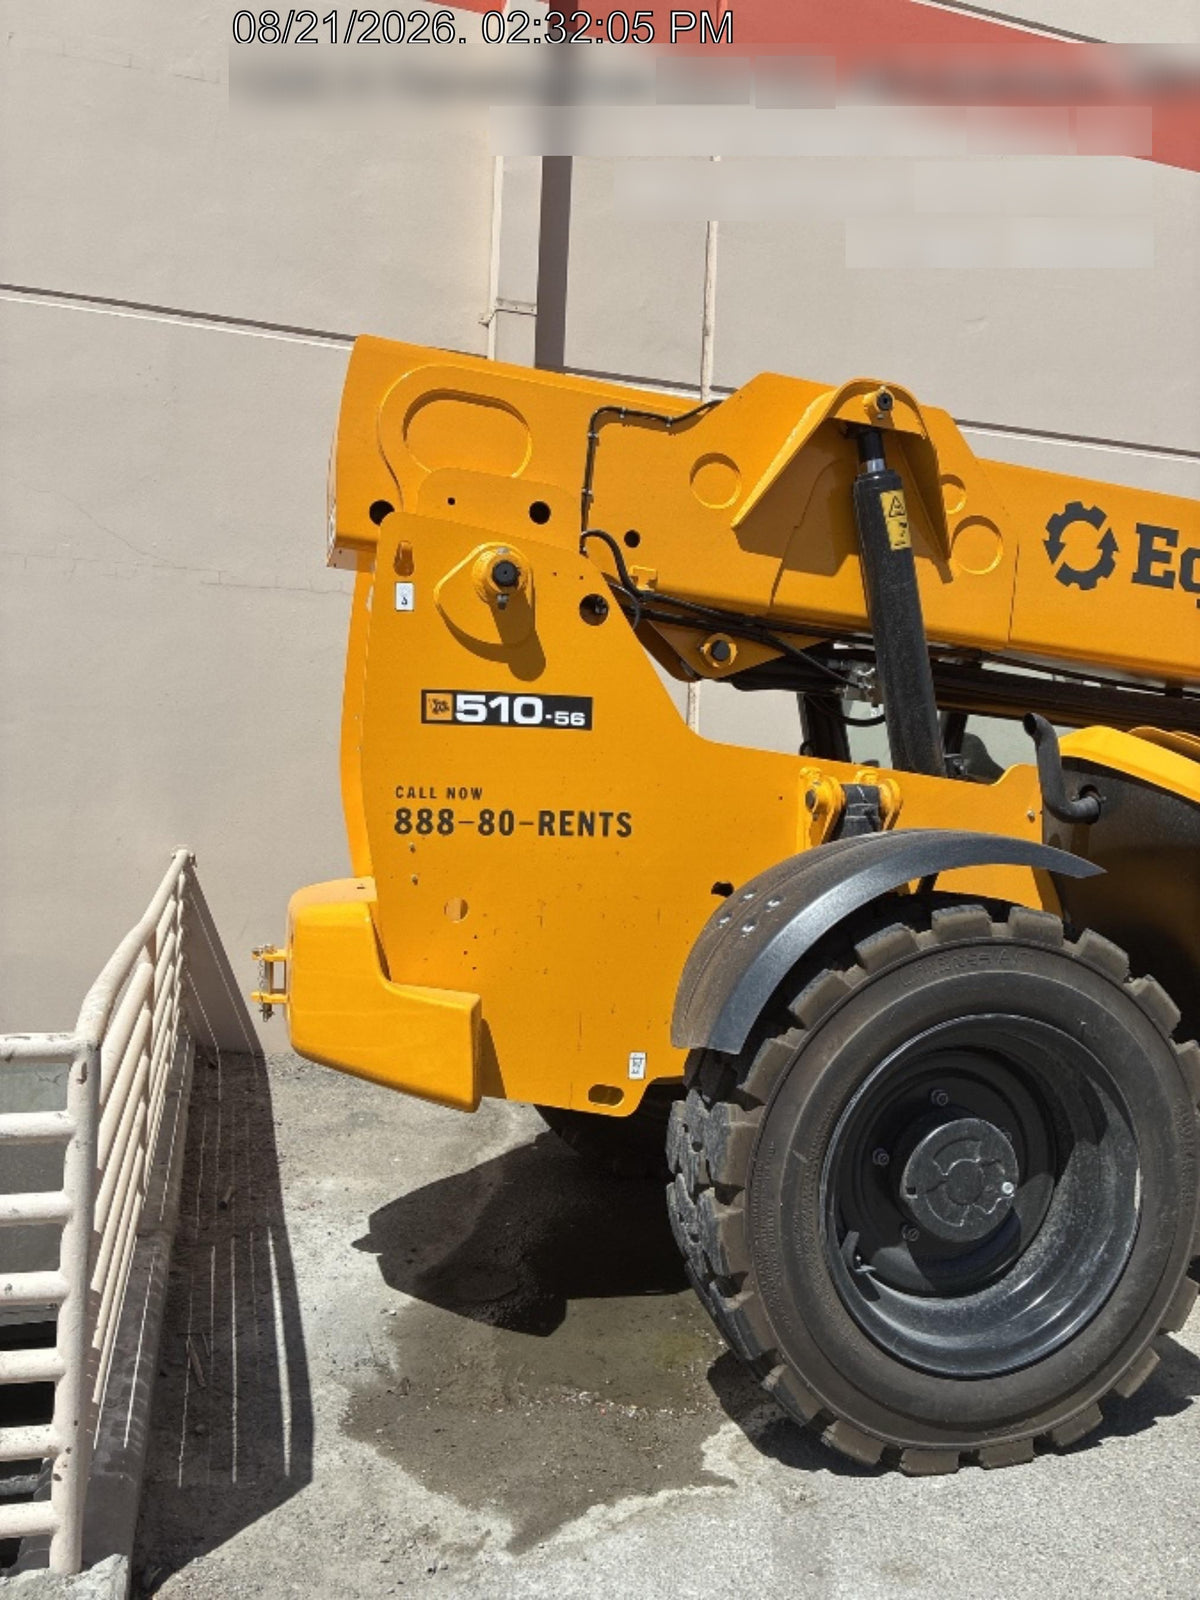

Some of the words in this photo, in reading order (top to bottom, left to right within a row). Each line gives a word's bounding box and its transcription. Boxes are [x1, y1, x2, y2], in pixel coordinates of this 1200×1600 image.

[455, 694, 586, 726] 510-56
[395, 785, 438, 800] CALL
[446, 786, 483, 801] NOW
[394, 807, 633, 838] 888-80-RENTS
